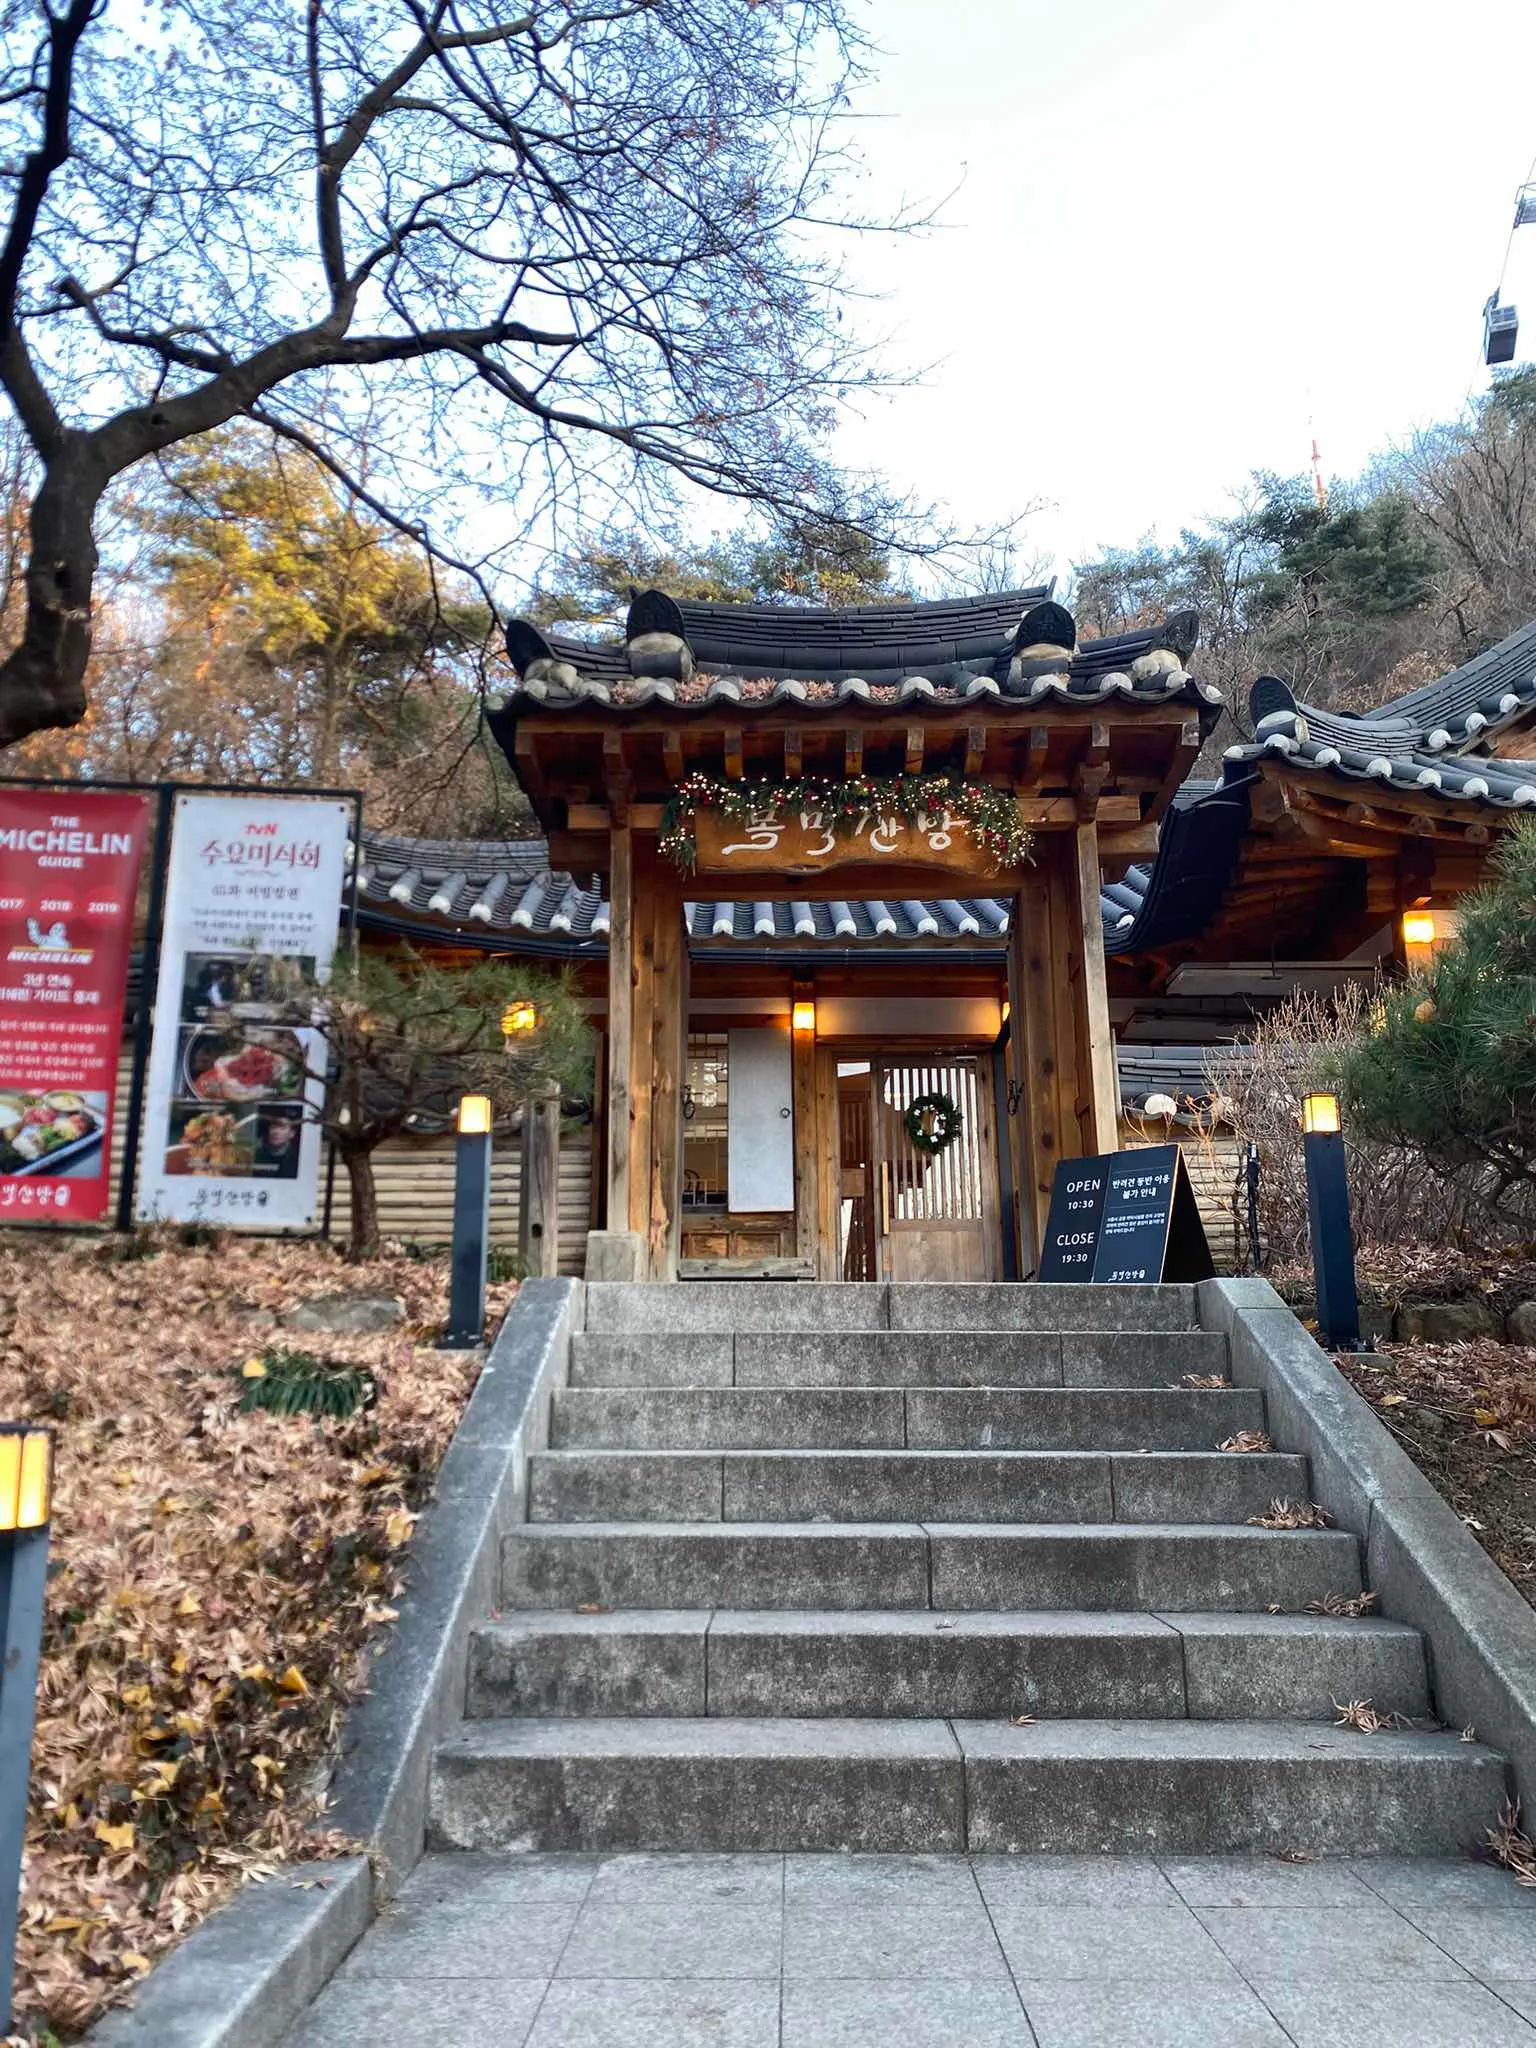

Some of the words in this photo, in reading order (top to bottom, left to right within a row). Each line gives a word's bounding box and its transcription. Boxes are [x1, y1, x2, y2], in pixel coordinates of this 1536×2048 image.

[50, 815, 80, 828] THE
[721, 809, 970, 856] 목멱산방
[0, 828, 131, 854] MICHELIN
[37, 855, 84, 868] GUIDE
[200, 838, 320, 870] 수요미식회
[0, 898, 24, 910] 017
[40, 900, 72, 912] 2018
[88, 902, 120, 914] 2019
[7, 949, 93, 964] MICHELIN
[1066, 1178, 1101, 1193] OPEN
[1112, 1177, 1135, 1189] 반려견
[1137, 1176, 1153, 1187] 동반
[1154, 1174, 1170, 1185] 이용
[0, 1183, 52, 1206] 멱산방
[1122, 1189, 1139, 1200] 불가
[1140, 1187, 1156, 1198] 안내
[1068, 1199, 1094, 1210] 10:30
[1056, 1232, 1095, 1246] CLOSE
[1062, 1253, 1088, 1264] 19:30
